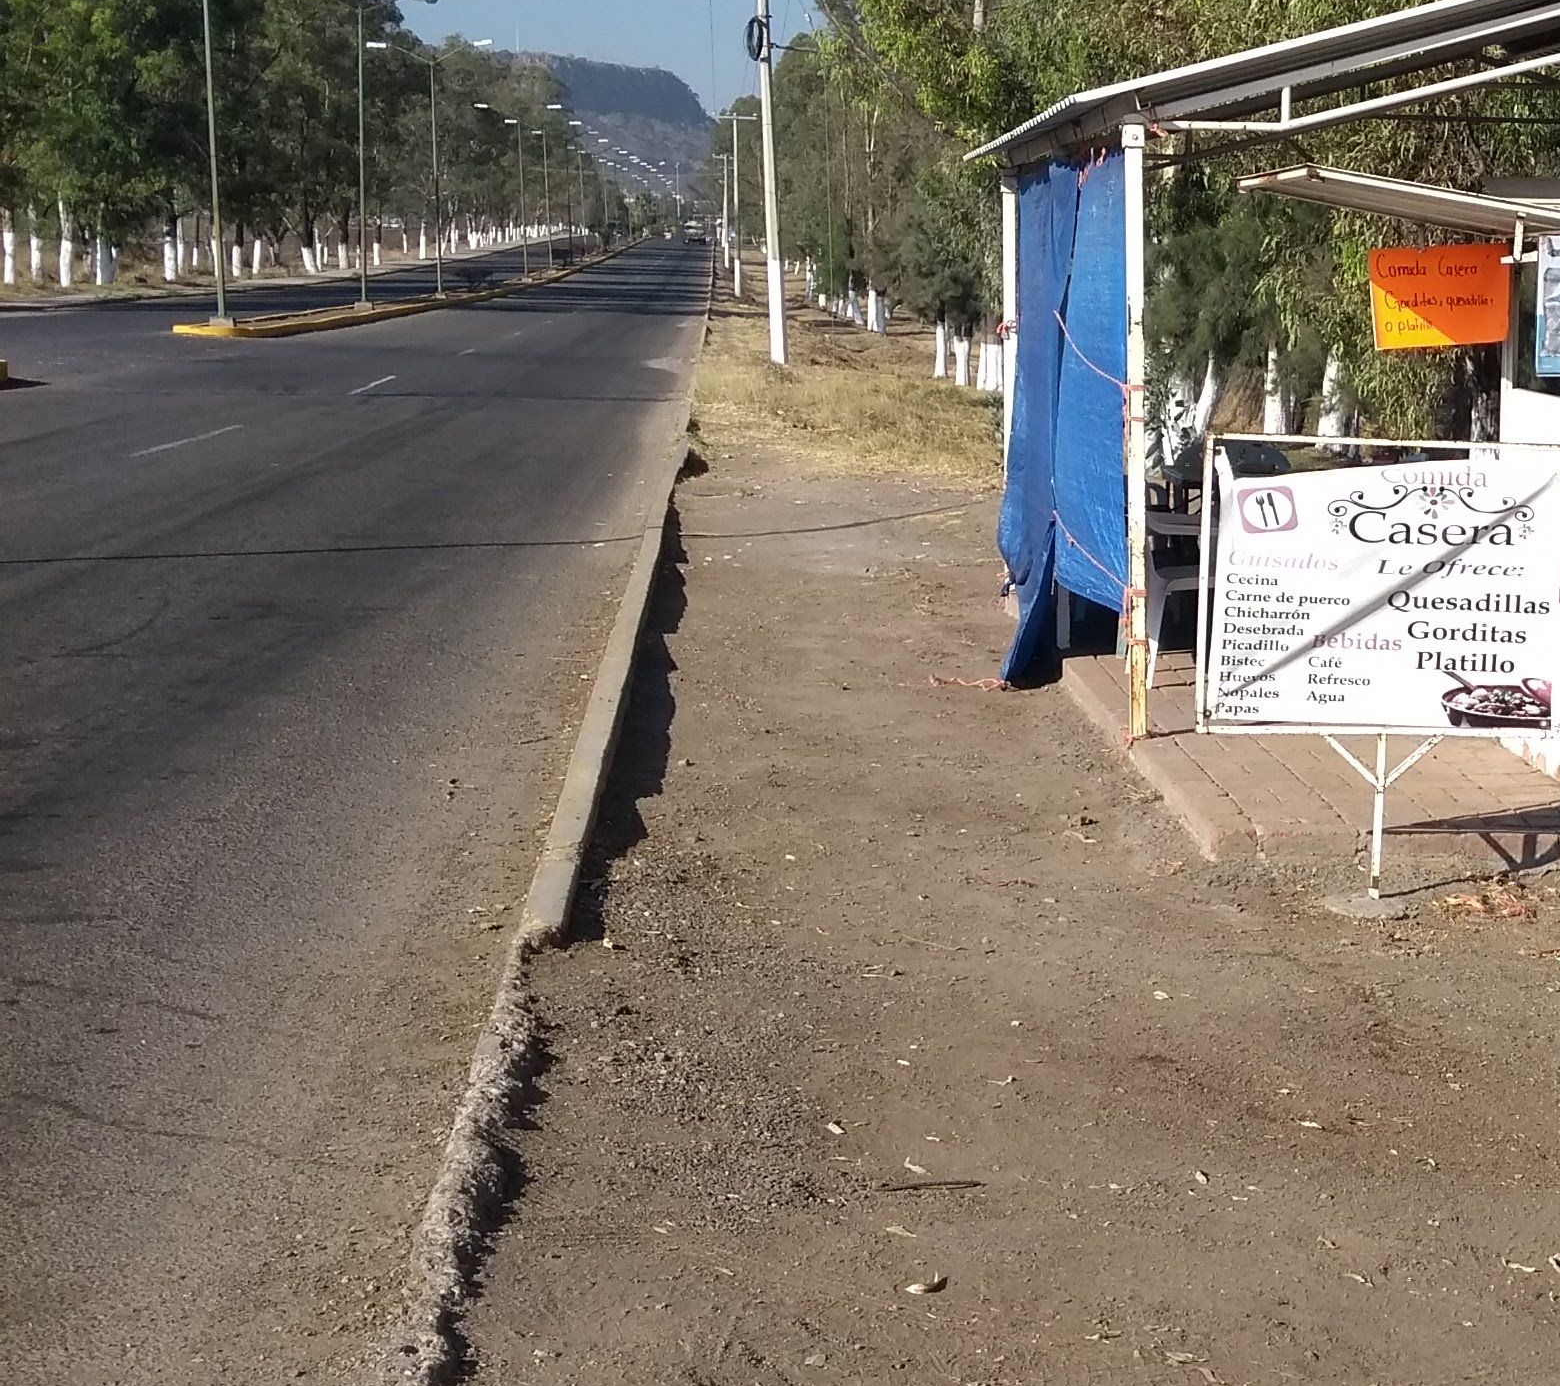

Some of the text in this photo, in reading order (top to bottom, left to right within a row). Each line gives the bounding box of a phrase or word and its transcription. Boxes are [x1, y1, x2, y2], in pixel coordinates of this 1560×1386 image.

[1381, 466, 1488, 487] Comida
[1349, 510, 1515, 546] Casera
[1228, 549, 1339, 571] Guisados
[1377, 558, 1524, 579] Le Ofrece:
[1226, 573, 1278, 586] Cecina
[1225, 589, 1351, 607] Carne de puerco
[1387, 590, 1551, 615] Quesadillas
[1224, 606, 1310, 620] Chicharrón
[1223, 622, 1304, 636] Desebrada
[1407, 620, 1527, 644] Gorditas
[1221, 639, 1290, 652] Picadillo
[1312, 631, 1402, 652] Bebidas
[1220, 655, 1266, 667] Bistec
[1307, 656, 1342, 668] Café
[1415, 651, 1515, 674] Platillo
[1218, 671, 1276, 683] Huevos
[1307, 673, 1371, 687] Refresco
[1217, 686, 1280, 701] Nopales
[1306, 691, 1346, 705] Agua
[1214, 702, 1260, 716] Papas
